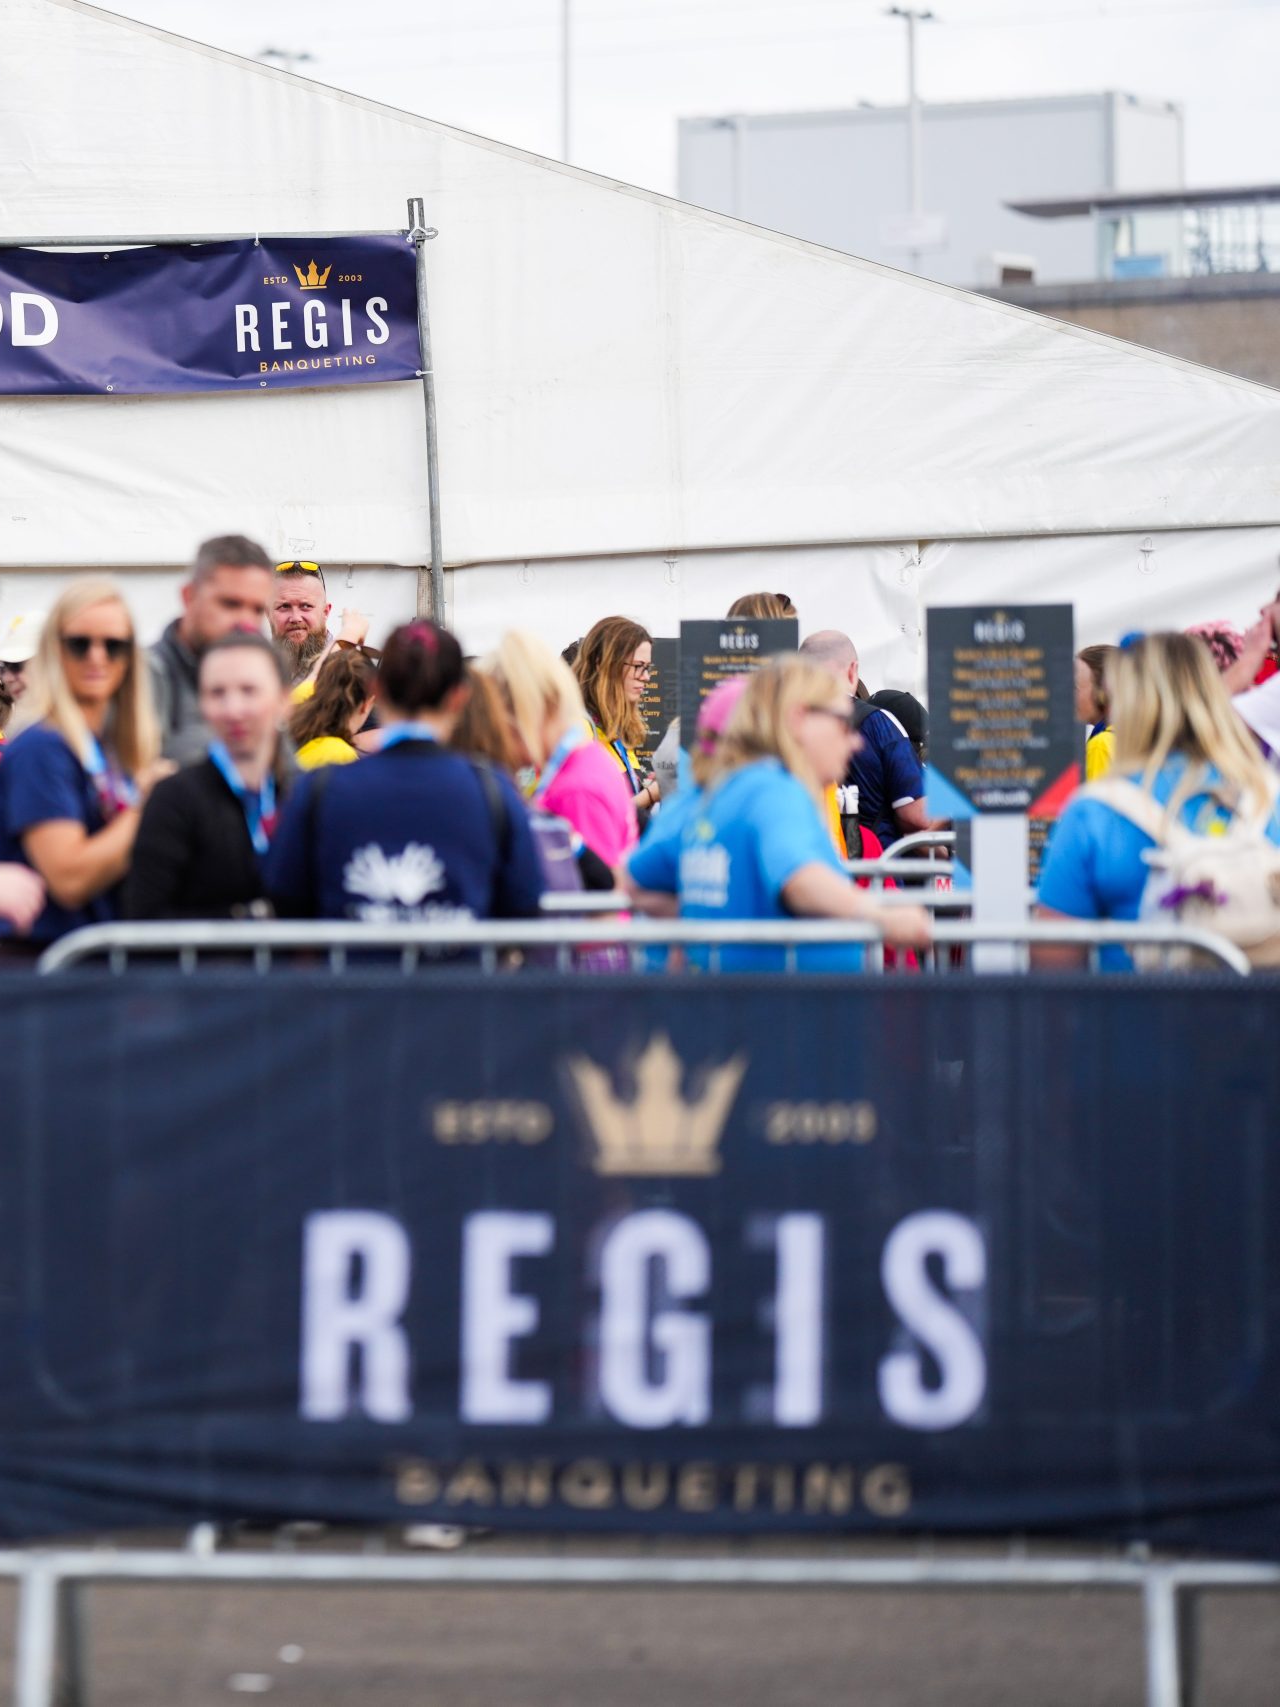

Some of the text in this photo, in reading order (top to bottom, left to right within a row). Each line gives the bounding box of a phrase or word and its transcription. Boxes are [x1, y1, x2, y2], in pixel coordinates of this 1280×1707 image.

[263, 274, 363, 285] ESTD 2003
[235, 296, 390, 352] REGIS
[260, 355, 376, 373] BANQUETING
[432, 1101, 552, 1144] ESTD
[300, 1208, 987, 1430] REGIS
[394, 1460, 915, 1516] BANQUETING
